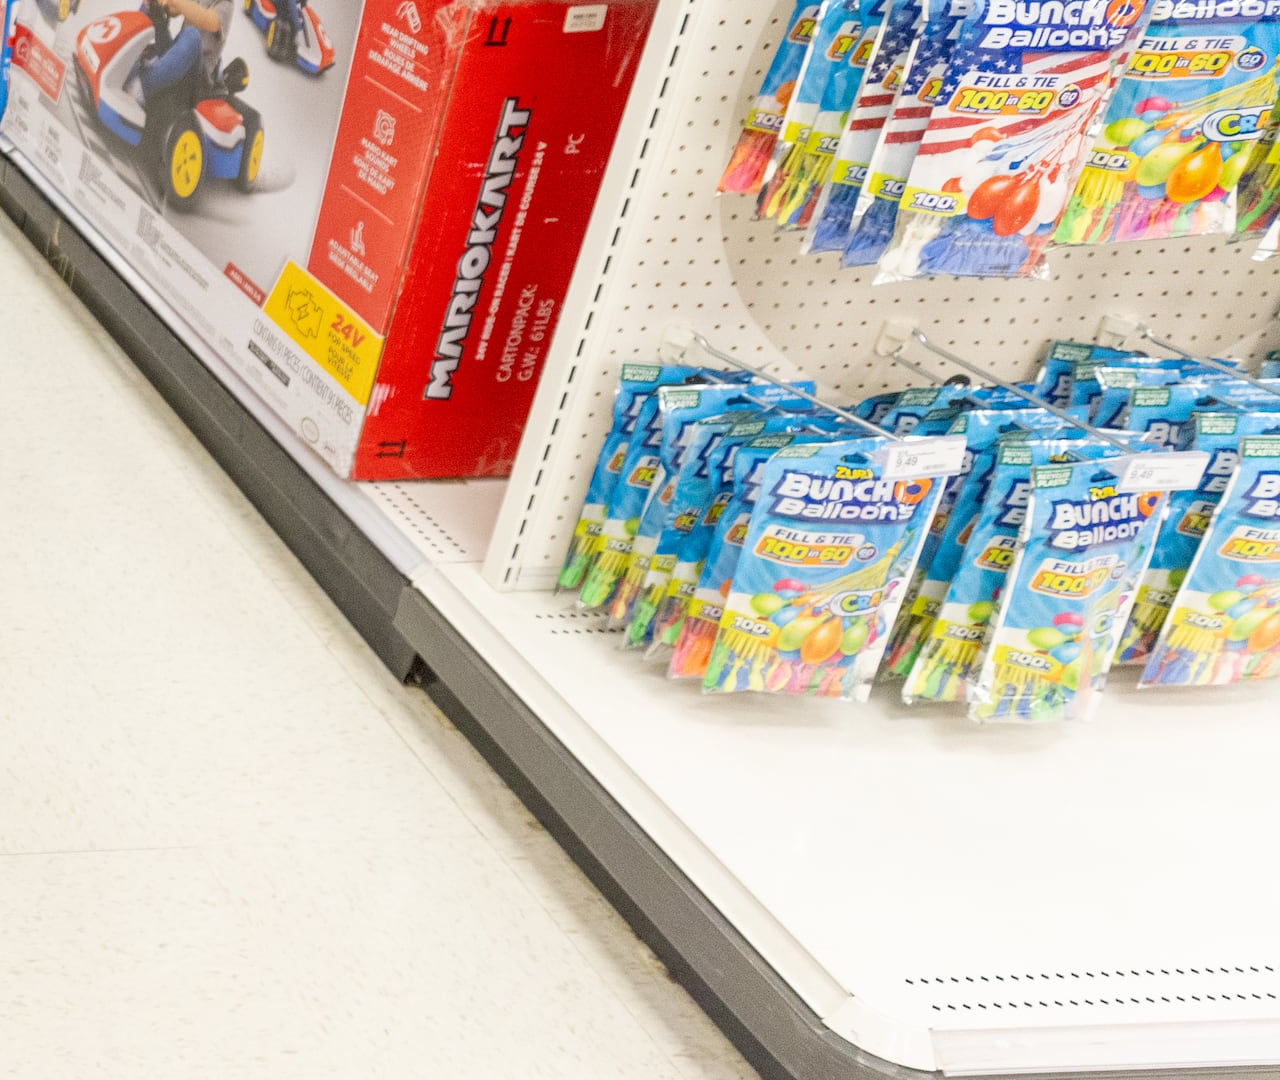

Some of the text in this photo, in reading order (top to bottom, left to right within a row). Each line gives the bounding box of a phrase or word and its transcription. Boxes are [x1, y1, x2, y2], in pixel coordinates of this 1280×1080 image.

[979, 25, 1129, 49] Balloons
[1139, 38, 1235, 51] FILL & TIE
[1175, 59, 1189, 68] in
[1190, 53, 1231, 71] 60
[973, 75, 1059, 88] FILL & TIE
[960, 90, 1054, 110] 100 in 60
[564, 133, 585, 156] PC
[330, 313, 365, 348] 24V
[774, 498, 916, 521] Balloons
[774, 529, 810, 543] FILL
[830, 535, 856, 545] TIE
[763, 539, 808, 557] 100
[819, 547, 851, 561] 60
